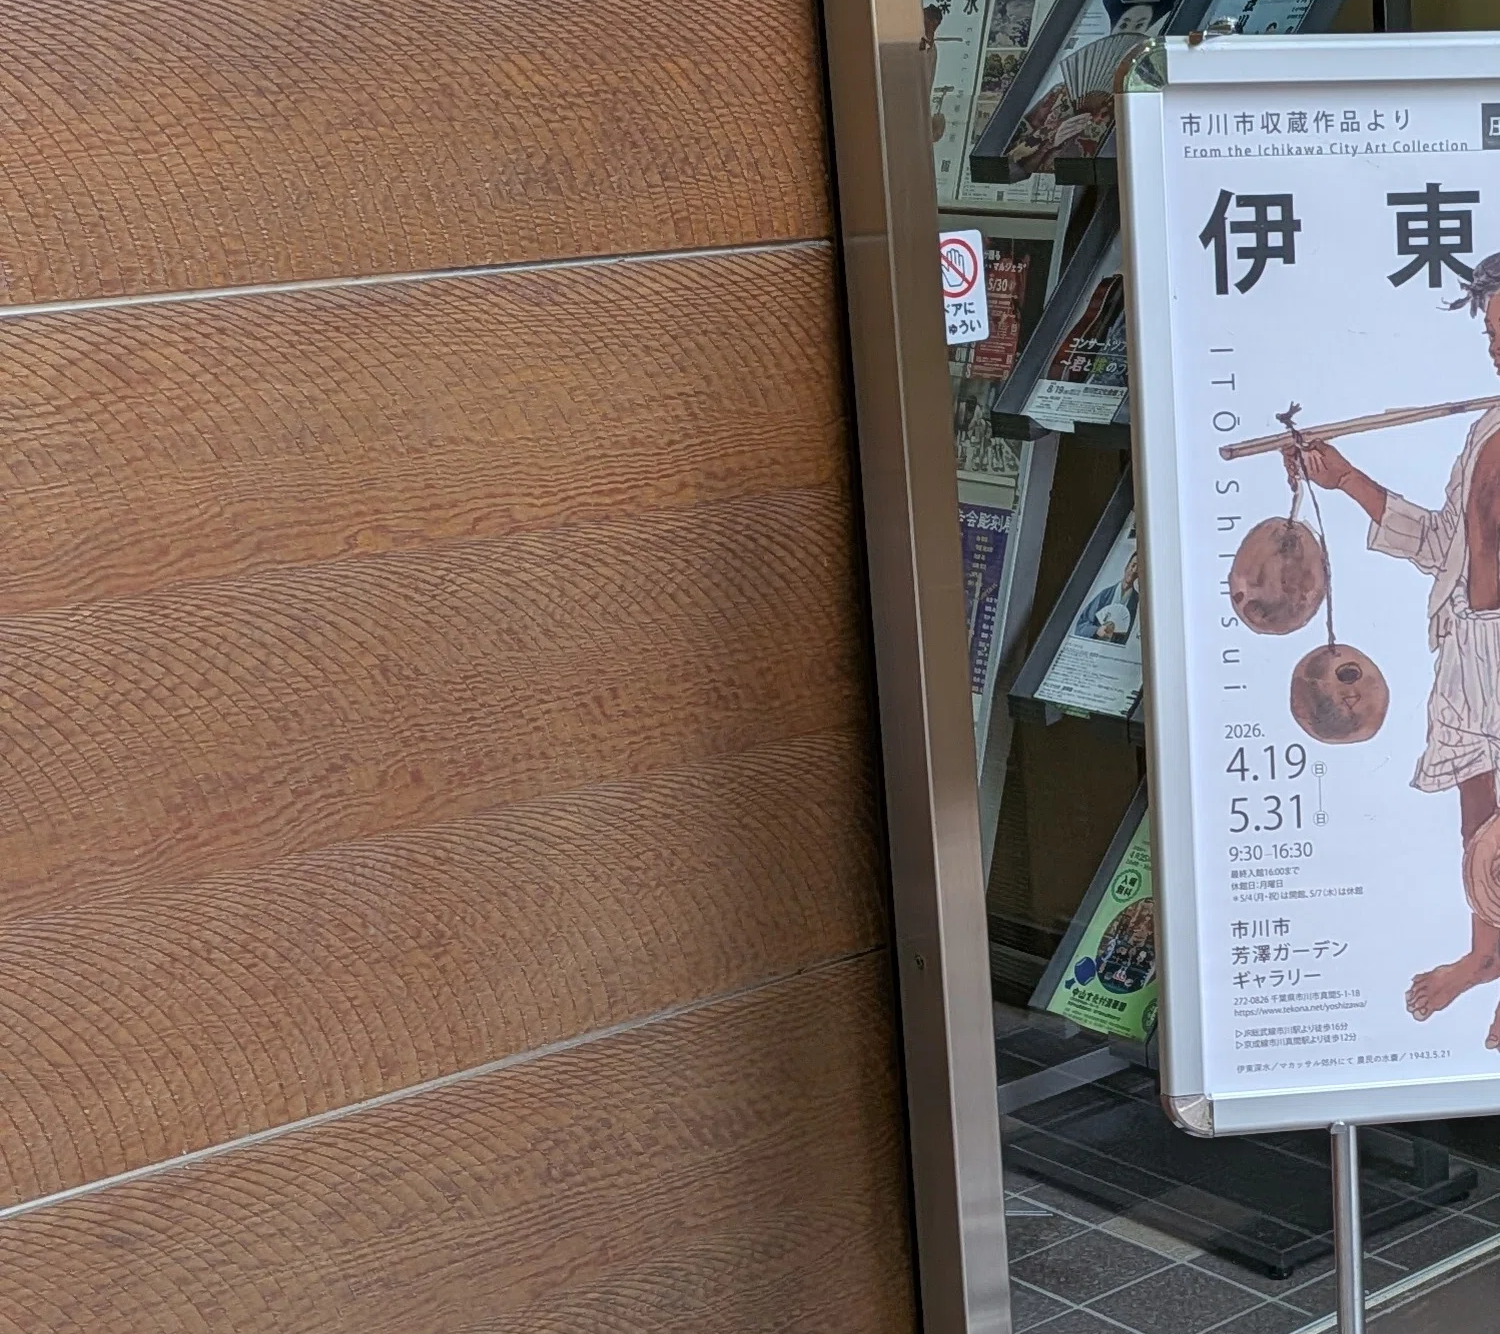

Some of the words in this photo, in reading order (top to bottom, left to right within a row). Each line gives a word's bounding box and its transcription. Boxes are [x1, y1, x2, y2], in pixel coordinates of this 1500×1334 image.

[1180, 109, 1410, 137] 市川市収蔵作品より
[1184, 145, 1221, 158] From
[1228, 144, 1251, 157] the
[1258, 143, 1323, 157] Ichikawa
[1329, 142, 1358, 158] City
[1364, 141, 1387, 154] Art
[1393, 140, 1469, 154] Collection
[1224, 723, 1266, 739] 2026.
[1226, 743, 1307, 782] 4.19
[1229, 794, 1302, 833] 5.31
[1230, 918, 1291, 940] 市川市
[1231, 940, 1349, 966] 芳澤ガーデン
[1232, 968, 1322, 990] ギャラリー
